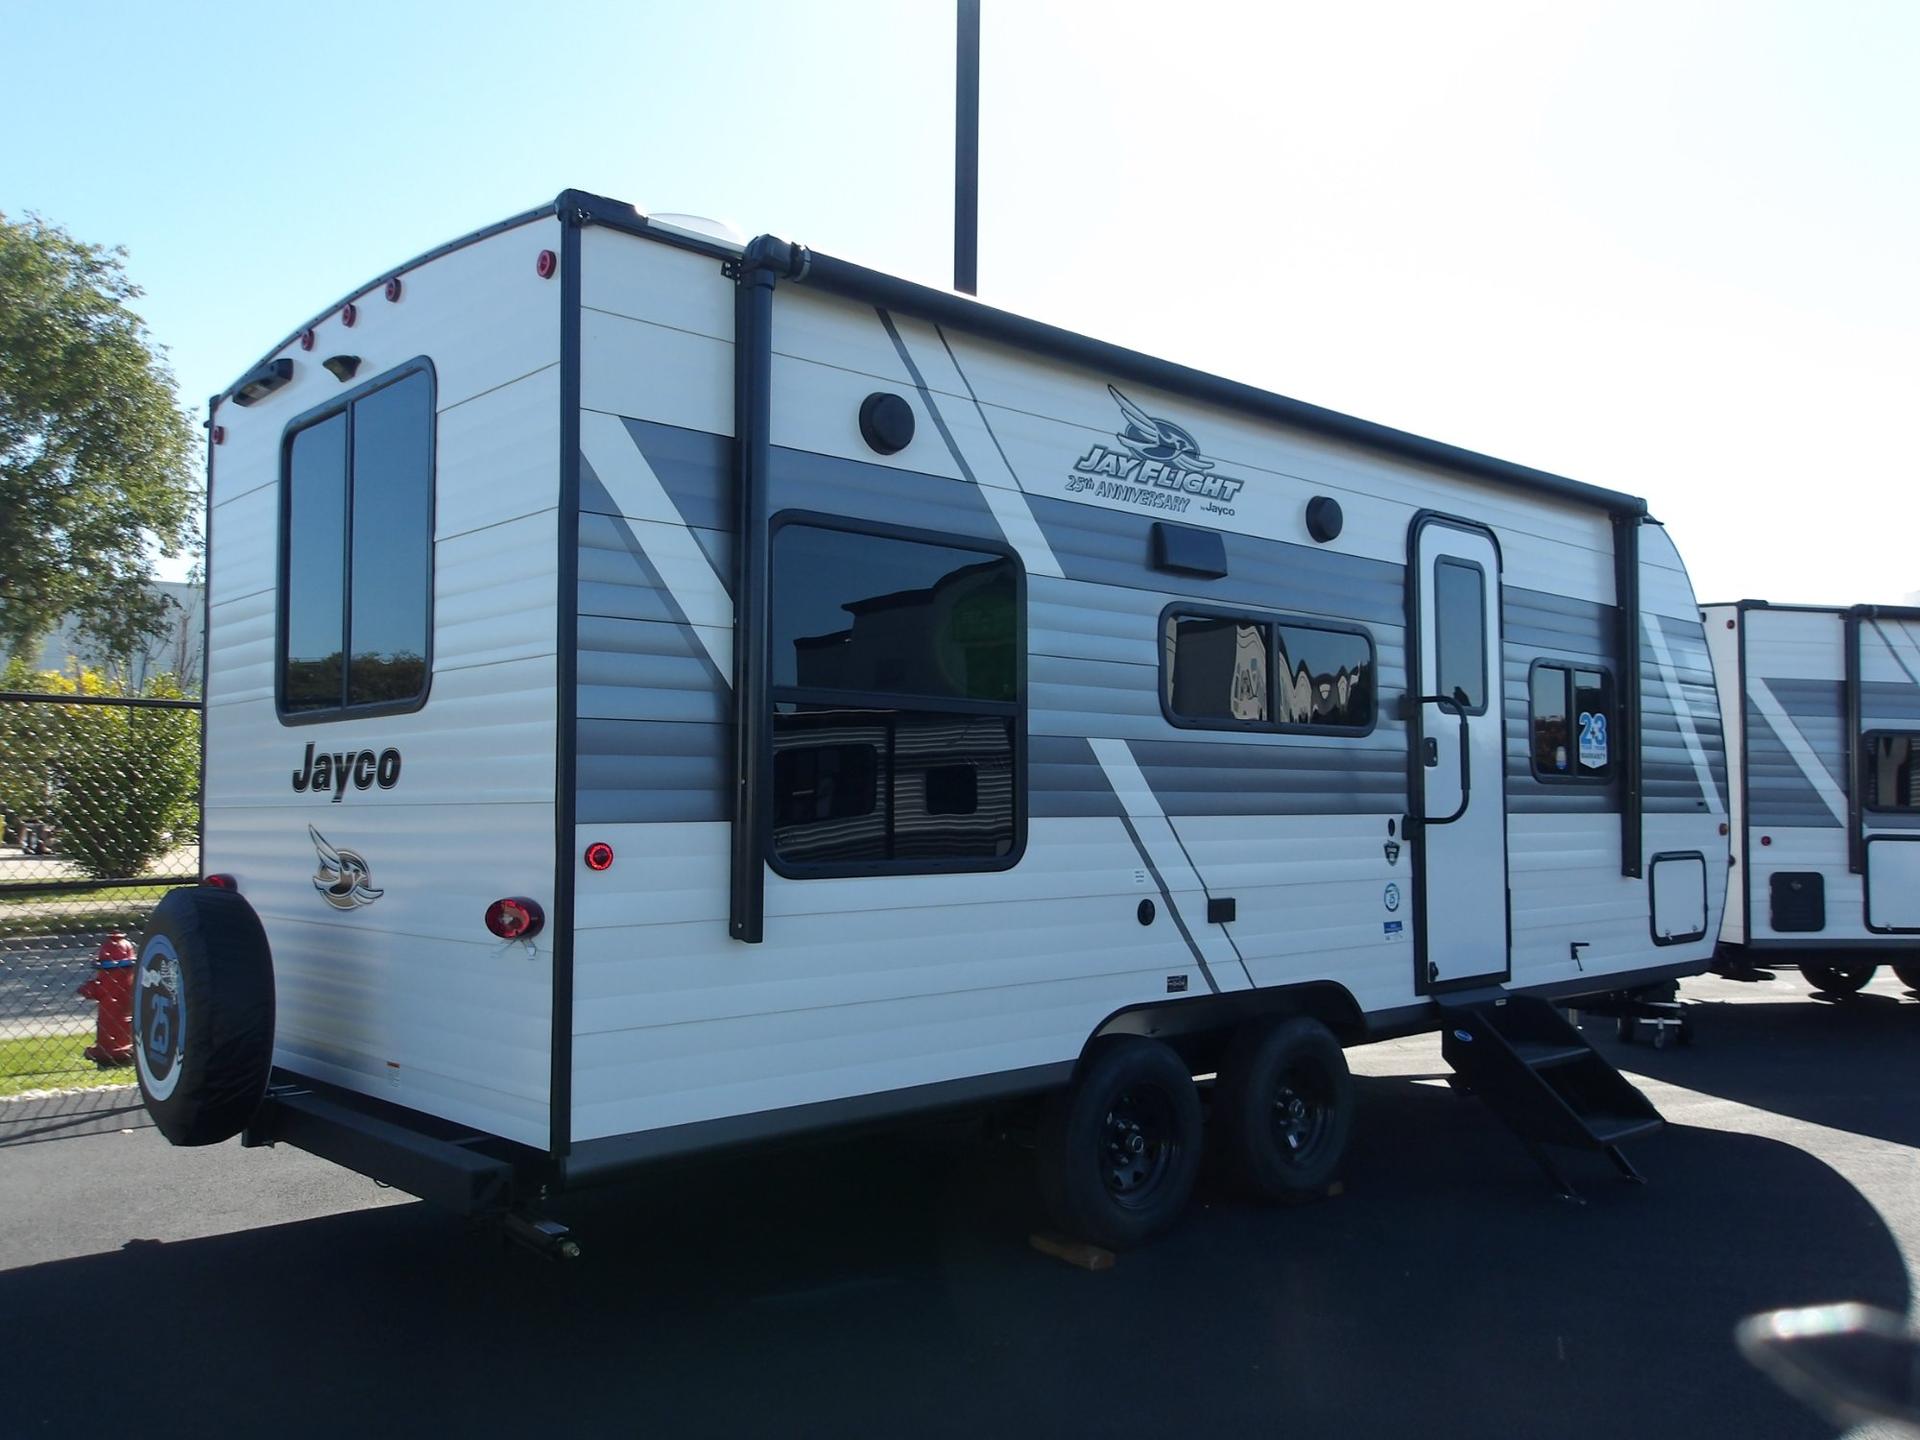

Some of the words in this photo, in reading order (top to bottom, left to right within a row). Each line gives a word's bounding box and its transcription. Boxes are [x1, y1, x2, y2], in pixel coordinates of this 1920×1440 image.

[1065, 475, 1095, 493] 25th
[1095, 481, 1191, 513] ANNIVERSARY
[1073, 444, 1141, 479] JAY
[1134, 458, 1245, 502] FLIGHT
[1205, 501, 1236, 517] Jayco
[292, 741, 402, 803] Jayco
